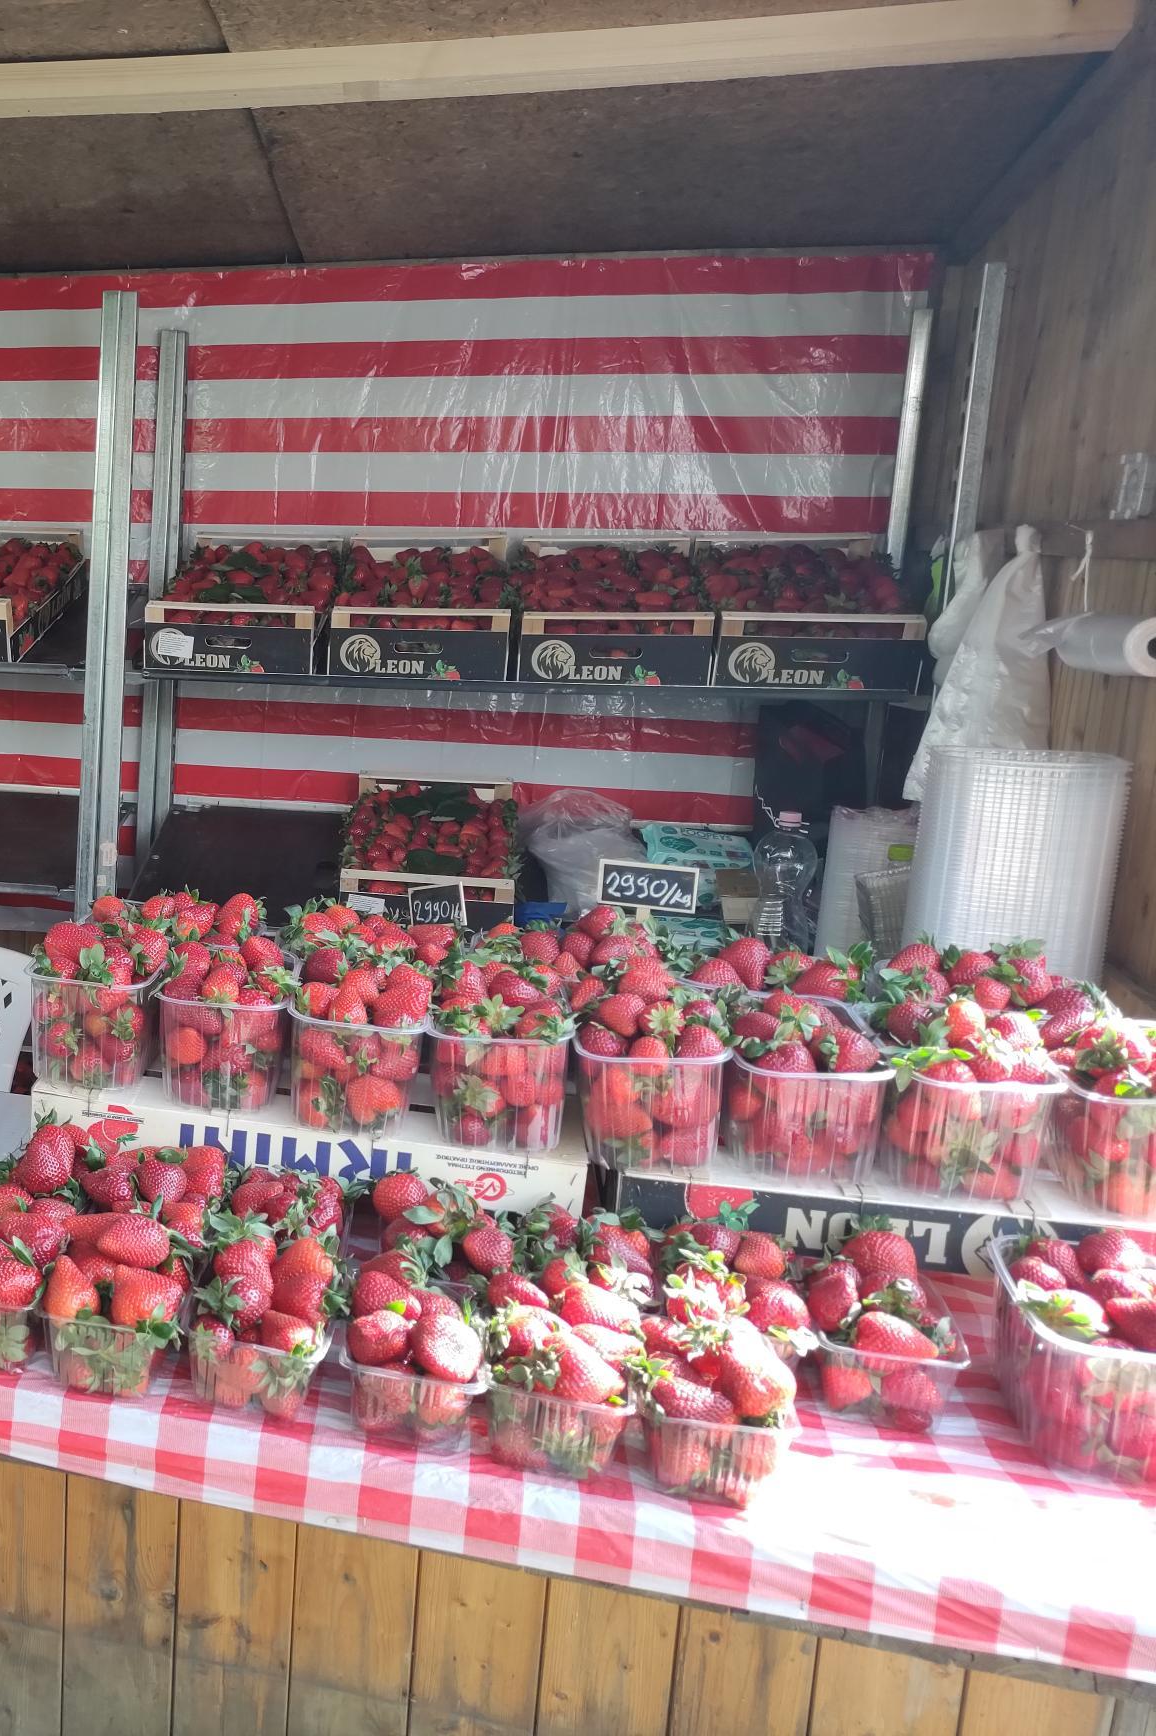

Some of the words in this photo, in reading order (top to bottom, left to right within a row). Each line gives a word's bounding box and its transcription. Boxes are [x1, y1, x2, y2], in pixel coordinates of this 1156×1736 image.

[184, 653, 231, 668] LEON
[374, 660, 424, 674] LEON
[567, 665, 622, 680] LEON
[765, 669, 825, 684] LEON
[606, 871, 693, 907] 2990/kg
